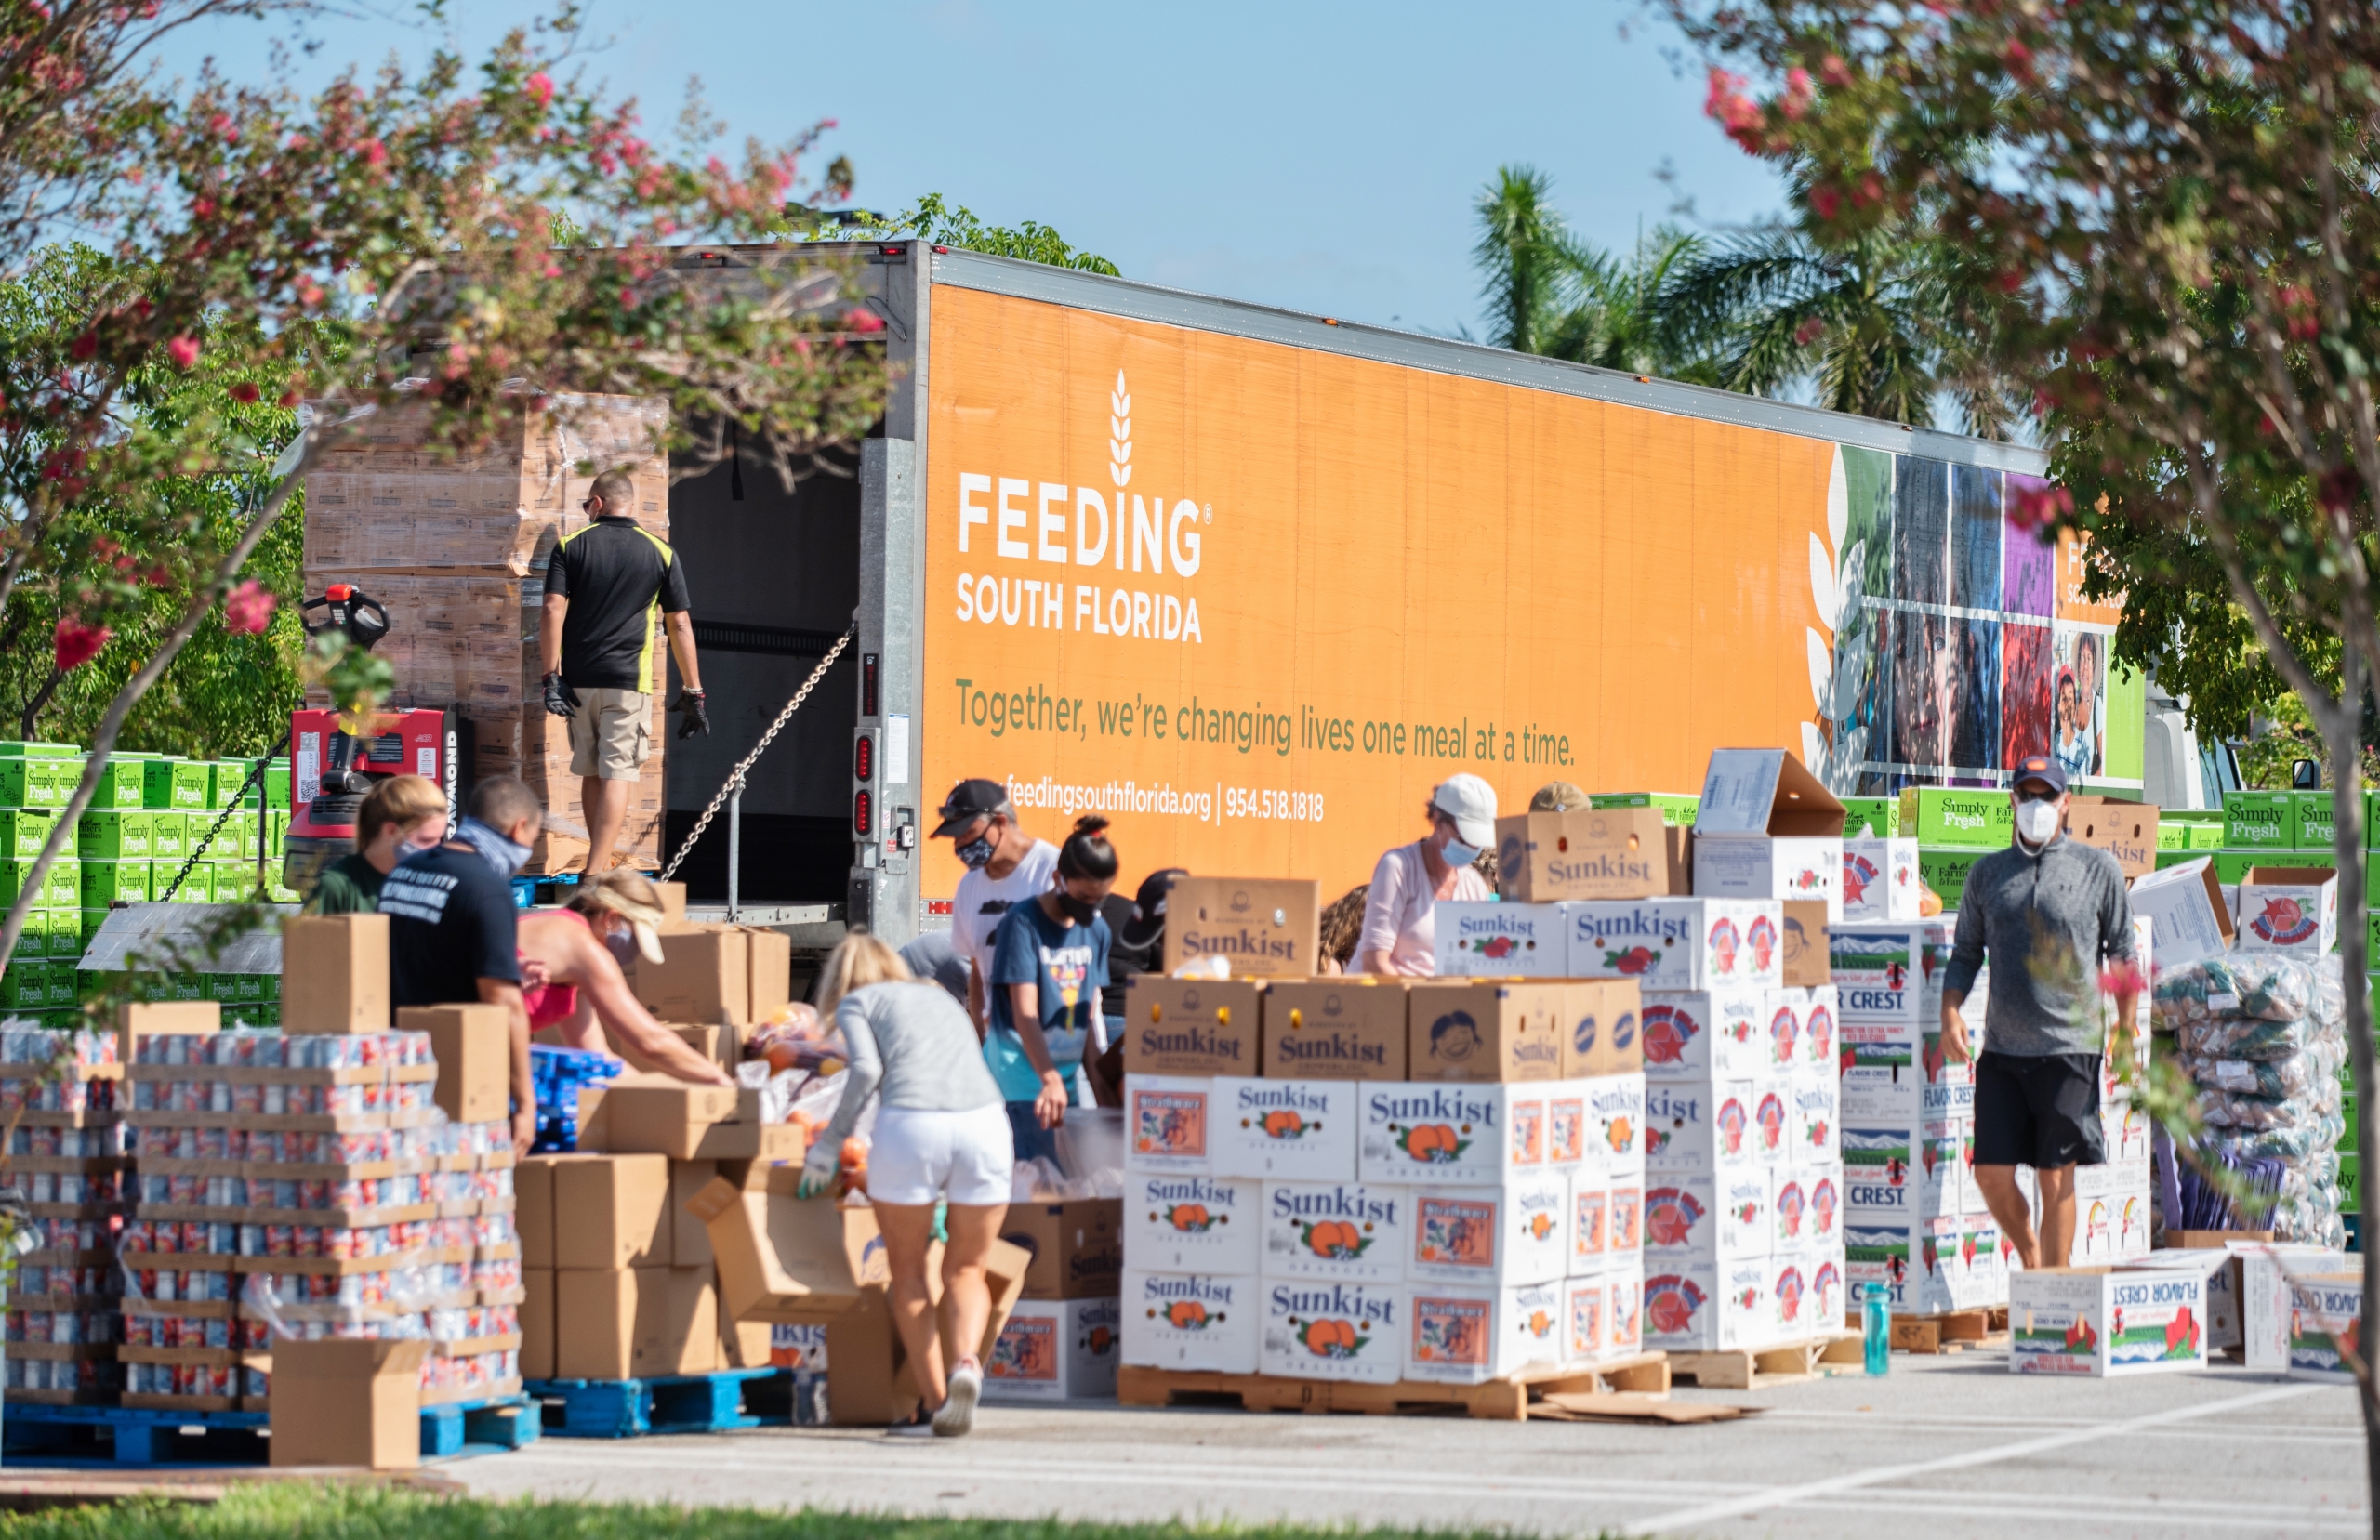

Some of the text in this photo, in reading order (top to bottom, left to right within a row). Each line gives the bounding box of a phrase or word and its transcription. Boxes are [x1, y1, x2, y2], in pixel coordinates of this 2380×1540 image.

[958, 470, 1201, 578] FEEDING
[955, 573, 1203, 644] SOUTH FLORIDA
[955, 678, 1576, 766] Together, we’re changing lives one meal at a time.
[28, 771, 56, 789] Simply
[118, 771, 141, 790] Simply
[176, 772, 205, 791] Simply
[219, 774, 242, 790] Simply
[447, 731, 457, 841] RAYMOND
[29, 785, 54, 800] Fresh
[118, 786, 139, 800] Fresh
[177, 786, 202, 802] Fresh
[956, 774, 1325, 823] feedingsouthflorida.org 954.518.1818
[1941, 798, 1989, 816] Simply
[2228, 803, 2284, 824] Simply
[19, 820, 44, 838] Simply
[1944, 813, 1985, 828] Fresh
[124, 821, 150, 839] Simply
[157, 822, 182, 839] Simply
[2231, 822, 2281, 838] Fresh
[20, 836, 42, 849] Fresh
[125, 836, 148, 850] Fresh
[157, 836, 180, 850] Fresh
[218, 837, 239, 850] Fresh
[1548, 853, 1652, 887] Sunkist
[51, 872, 77, 888] Simply
[119, 872, 146, 888] Simply
[53, 887, 75, 900] Fresh
[120, 888, 144, 901] Fresh
[186, 888, 206, 901] Fresh
[217, 888, 238, 900] Fresh
[52, 920, 77, 938] Simply
[1459, 914, 1534, 937] Sunkist
[1577, 908, 1690, 941] Sunkist
[18, 937, 42, 950] Fresh
[53, 935, 76, 949] Fresh
[1182, 929, 1297, 961] Sunkist
[19, 972, 45, 990] Simply
[50, 971, 74, 988] Simply
[240, 981, 260, 994] Fresh
[20, 987, 43, 1000] Fresh
[51, 986, 73, 999] Fresh
[177, 985, 200, 998] Fresh
[213, 983, 234, 996] Fresh
[1850, 991, 1904, 1009] CREST
[1140, 1027, 1243, 1060] Sunkist
[1278, 1033, 1388, 1066] Sunkist
[1513, 1035, 1558, 1065] Sunkist
[1139, 1094, 1201, 1110] Strathmore
[1237, 1085, 1329, 1113] Sunkist
[1591, 1083, 1642, 1117] Sunkist
[1646, 1088, 1701, 1124] kist
[1924, 1086, 1951, 1109] FLAVOR
[1369, 1089, 1497, 1126] Sunkist
[1387, 1167, 1476, 1178] ORANGES
[1146, 1177, 1236, 1206] Sunkist
[1851, 1186, 1904, 1205] CREST
[1273, 1185, 1398, 1225] Sunkist
[1289, 1263, 1378, 1276] ORANGES
[1144, 1276, 1233, 1305] Sunkist
[2113, 1284, 2149, 1305] CREST
[2152, 1282, 2199, 1302] FLAVOR
[1271, 1284, 1396, 1325] Sunkist
[1286, 1361, 1374, 1375] ORANGES
